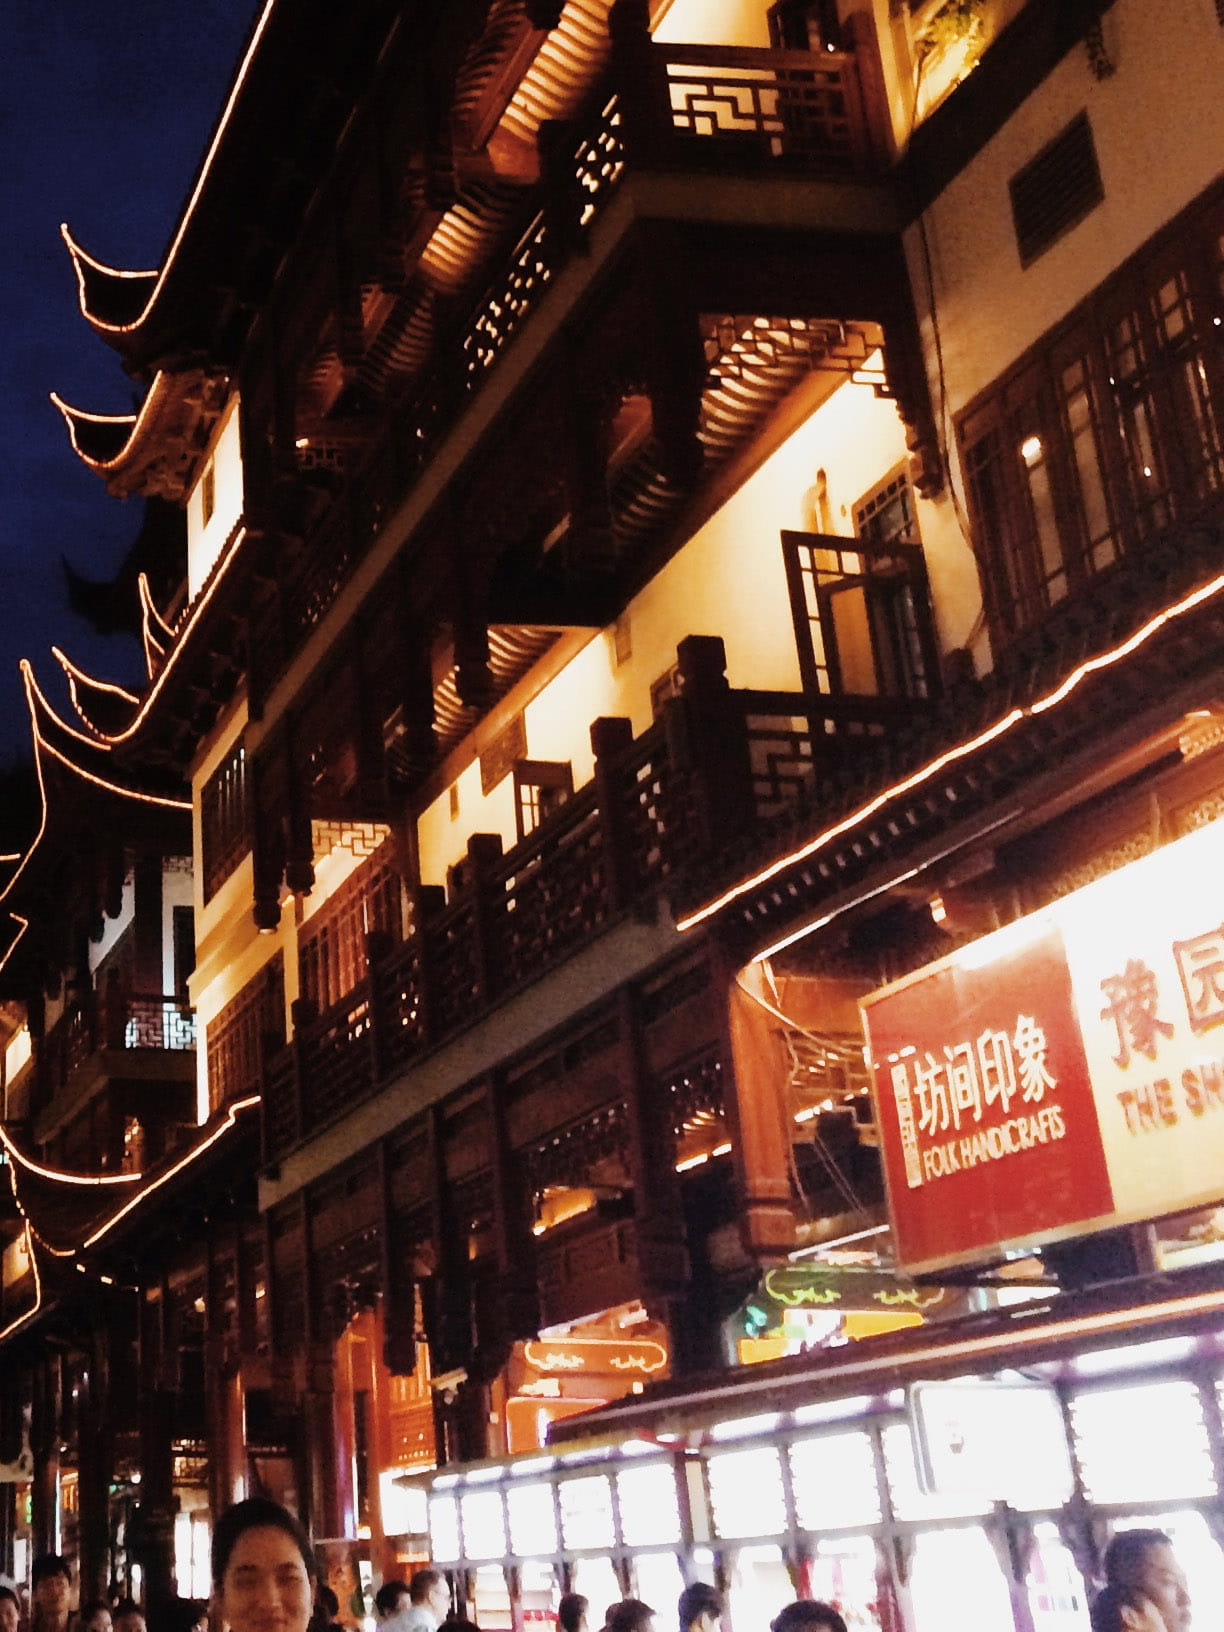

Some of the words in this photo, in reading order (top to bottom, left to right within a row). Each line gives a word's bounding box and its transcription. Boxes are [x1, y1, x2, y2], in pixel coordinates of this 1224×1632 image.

[913, 1015, 1058, 1136] 坊间印象
[1117, 1079, 1177, 1137] THE
[1182, 1062, 1224, 1116] SH
[923, 1141, 961, 1181] FOLK
[960, 1105, 1066, 1167] HANDICRAFTS
